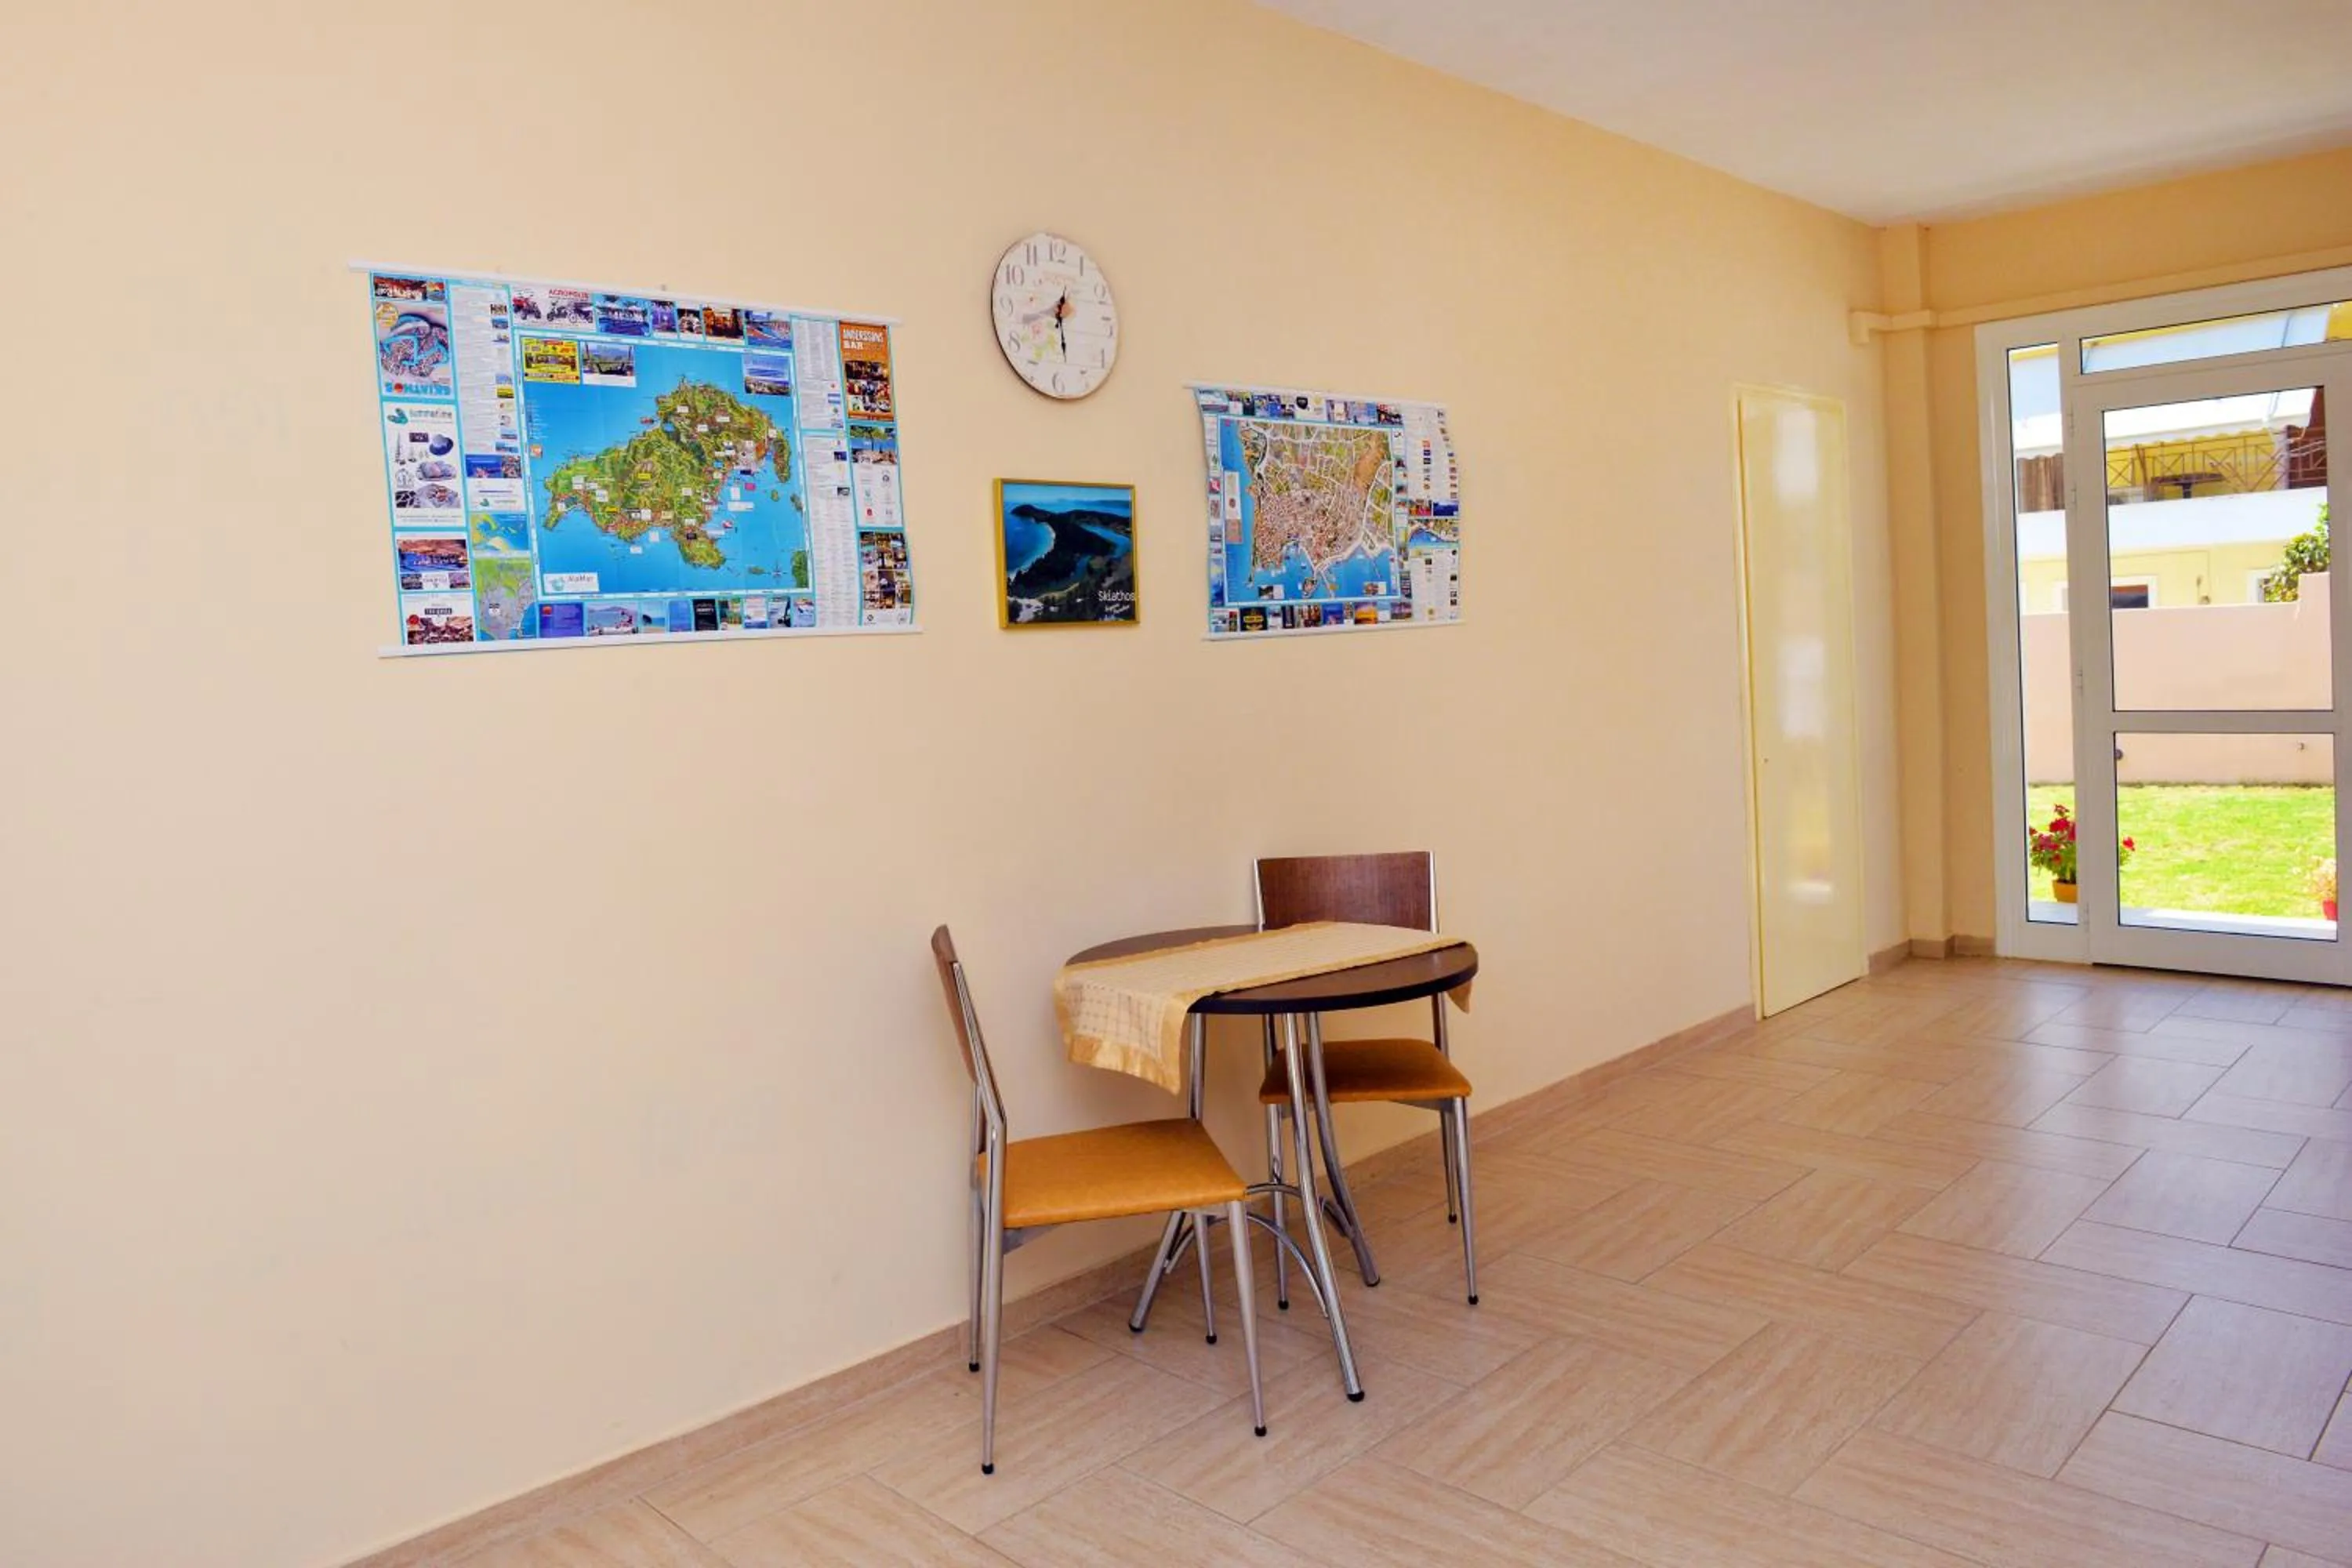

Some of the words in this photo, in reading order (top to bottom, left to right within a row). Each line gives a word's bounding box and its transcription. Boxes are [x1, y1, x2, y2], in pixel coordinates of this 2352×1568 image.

[1026, 244, 1038, 267] 11
[1049, 240, 1067, 264] 12
[1006, 265, 1025, 286] 10
[1000, 295, 1013, 316] 9
[843, 339, 863, 350] BAR
[1052, 372, 1065, 396] 6
[1098, 589, 1136, 601] Skiathos
